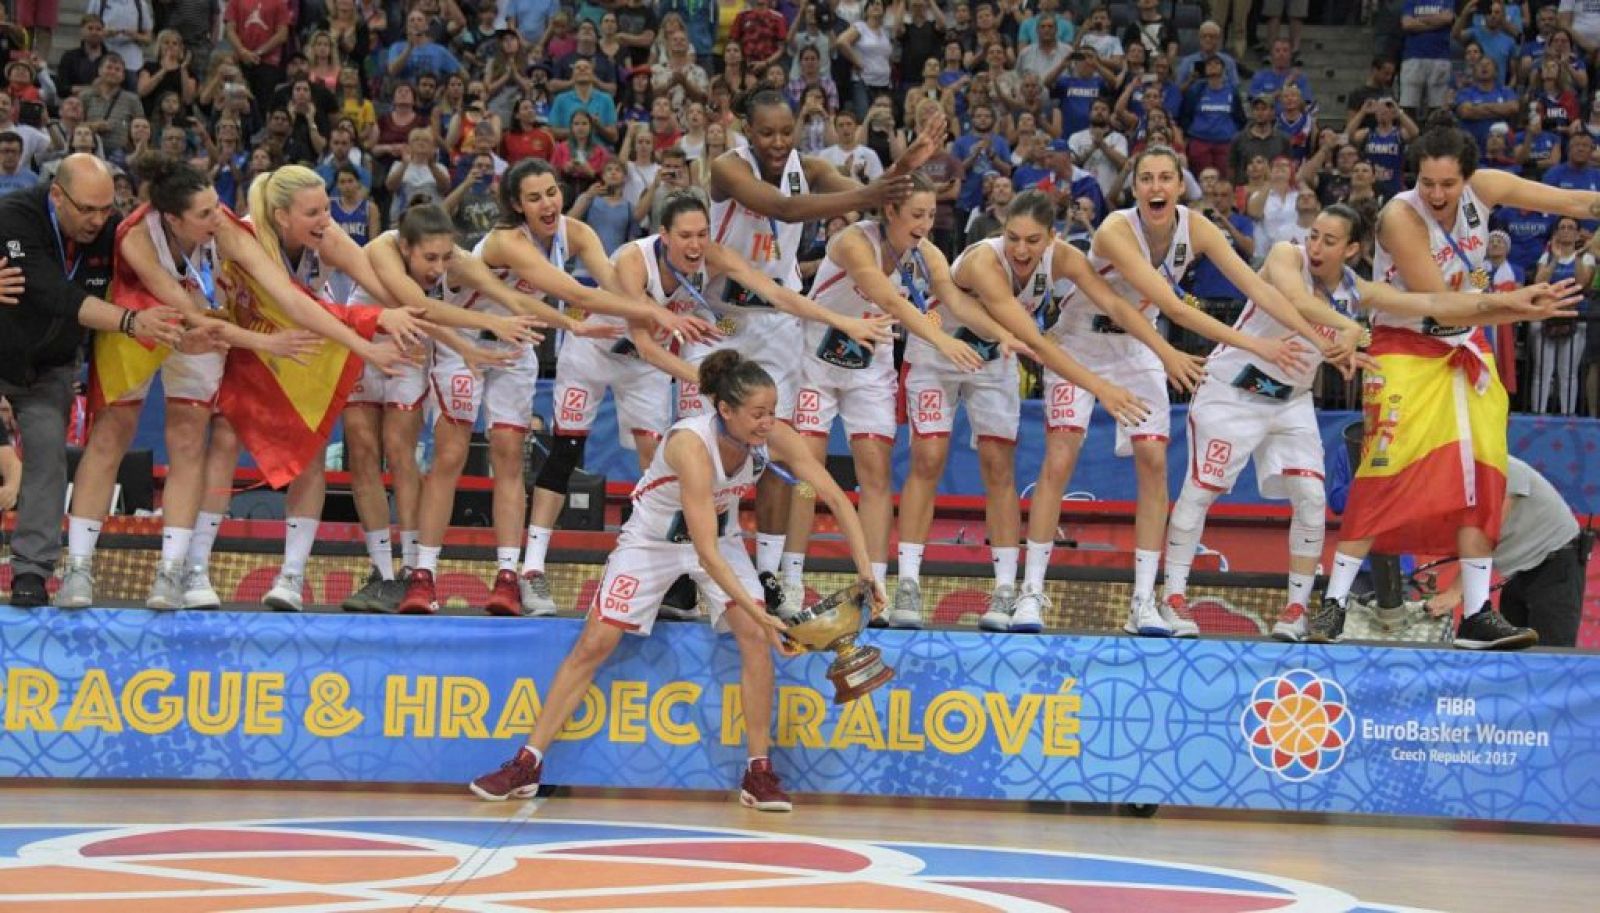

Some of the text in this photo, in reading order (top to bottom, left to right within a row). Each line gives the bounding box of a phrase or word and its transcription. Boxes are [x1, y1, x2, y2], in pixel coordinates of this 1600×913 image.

[751, 233, 773, 262] 14
[0, 667, 285, 736] RAGUE
[304, 672, 365, 737] &
[384, 675, 703, 746] HRADEC
[1436, 697, 1476, 717] FIBA
[1362, 718, 1550, 747] EuroBasket Women
[1391, 747, 1518, 766] Czech Republic 2017
